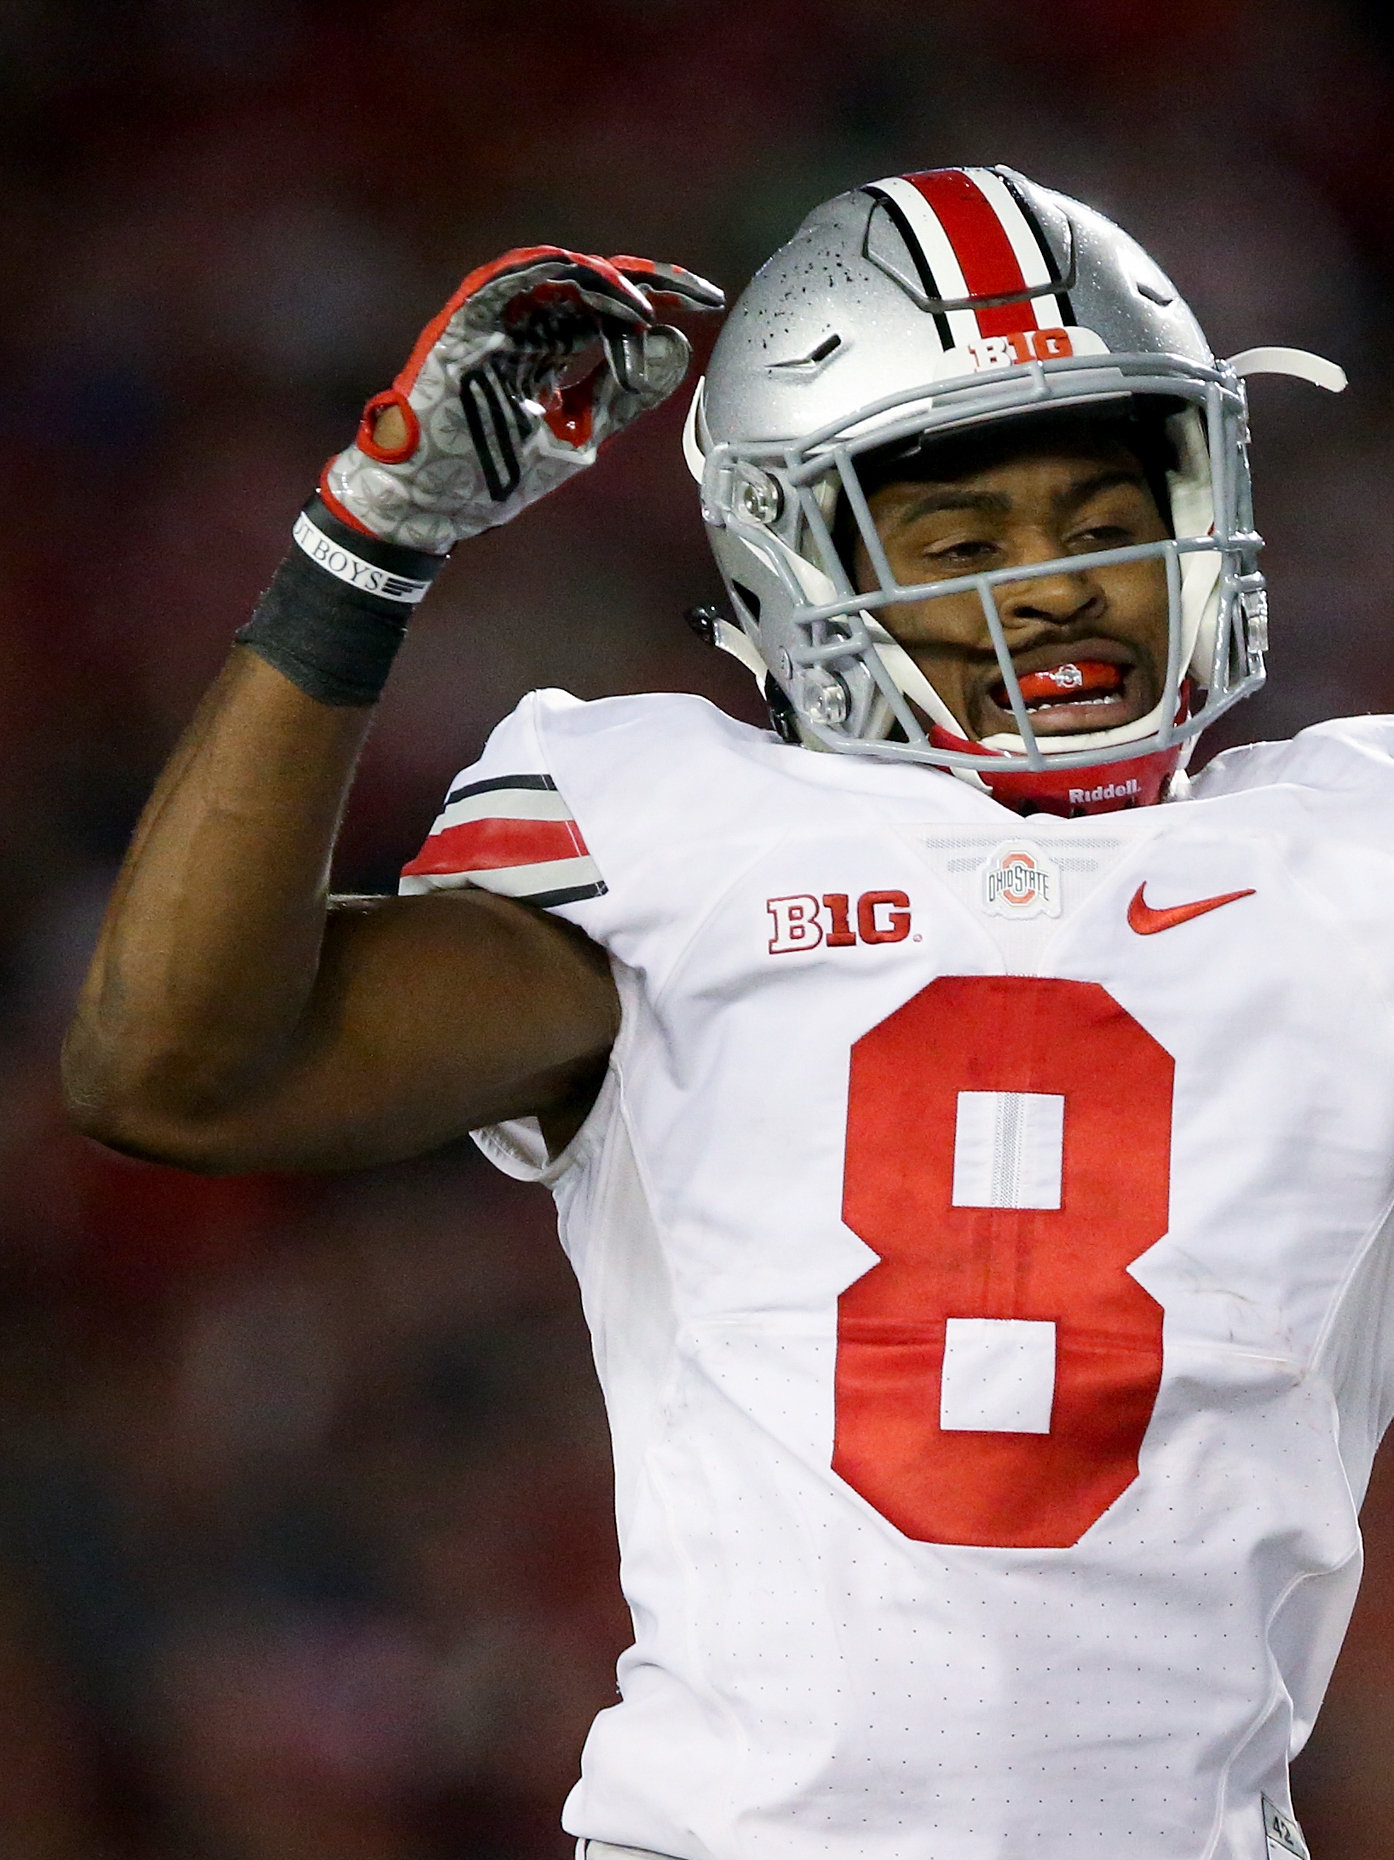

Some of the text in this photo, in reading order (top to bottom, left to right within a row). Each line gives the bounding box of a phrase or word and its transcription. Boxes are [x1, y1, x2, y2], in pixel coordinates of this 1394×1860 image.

[312, 539, 383, 591] BOYS
[1069, 779, 1141, 803] Riddell
[831, 975, 1176, 1549] 8
